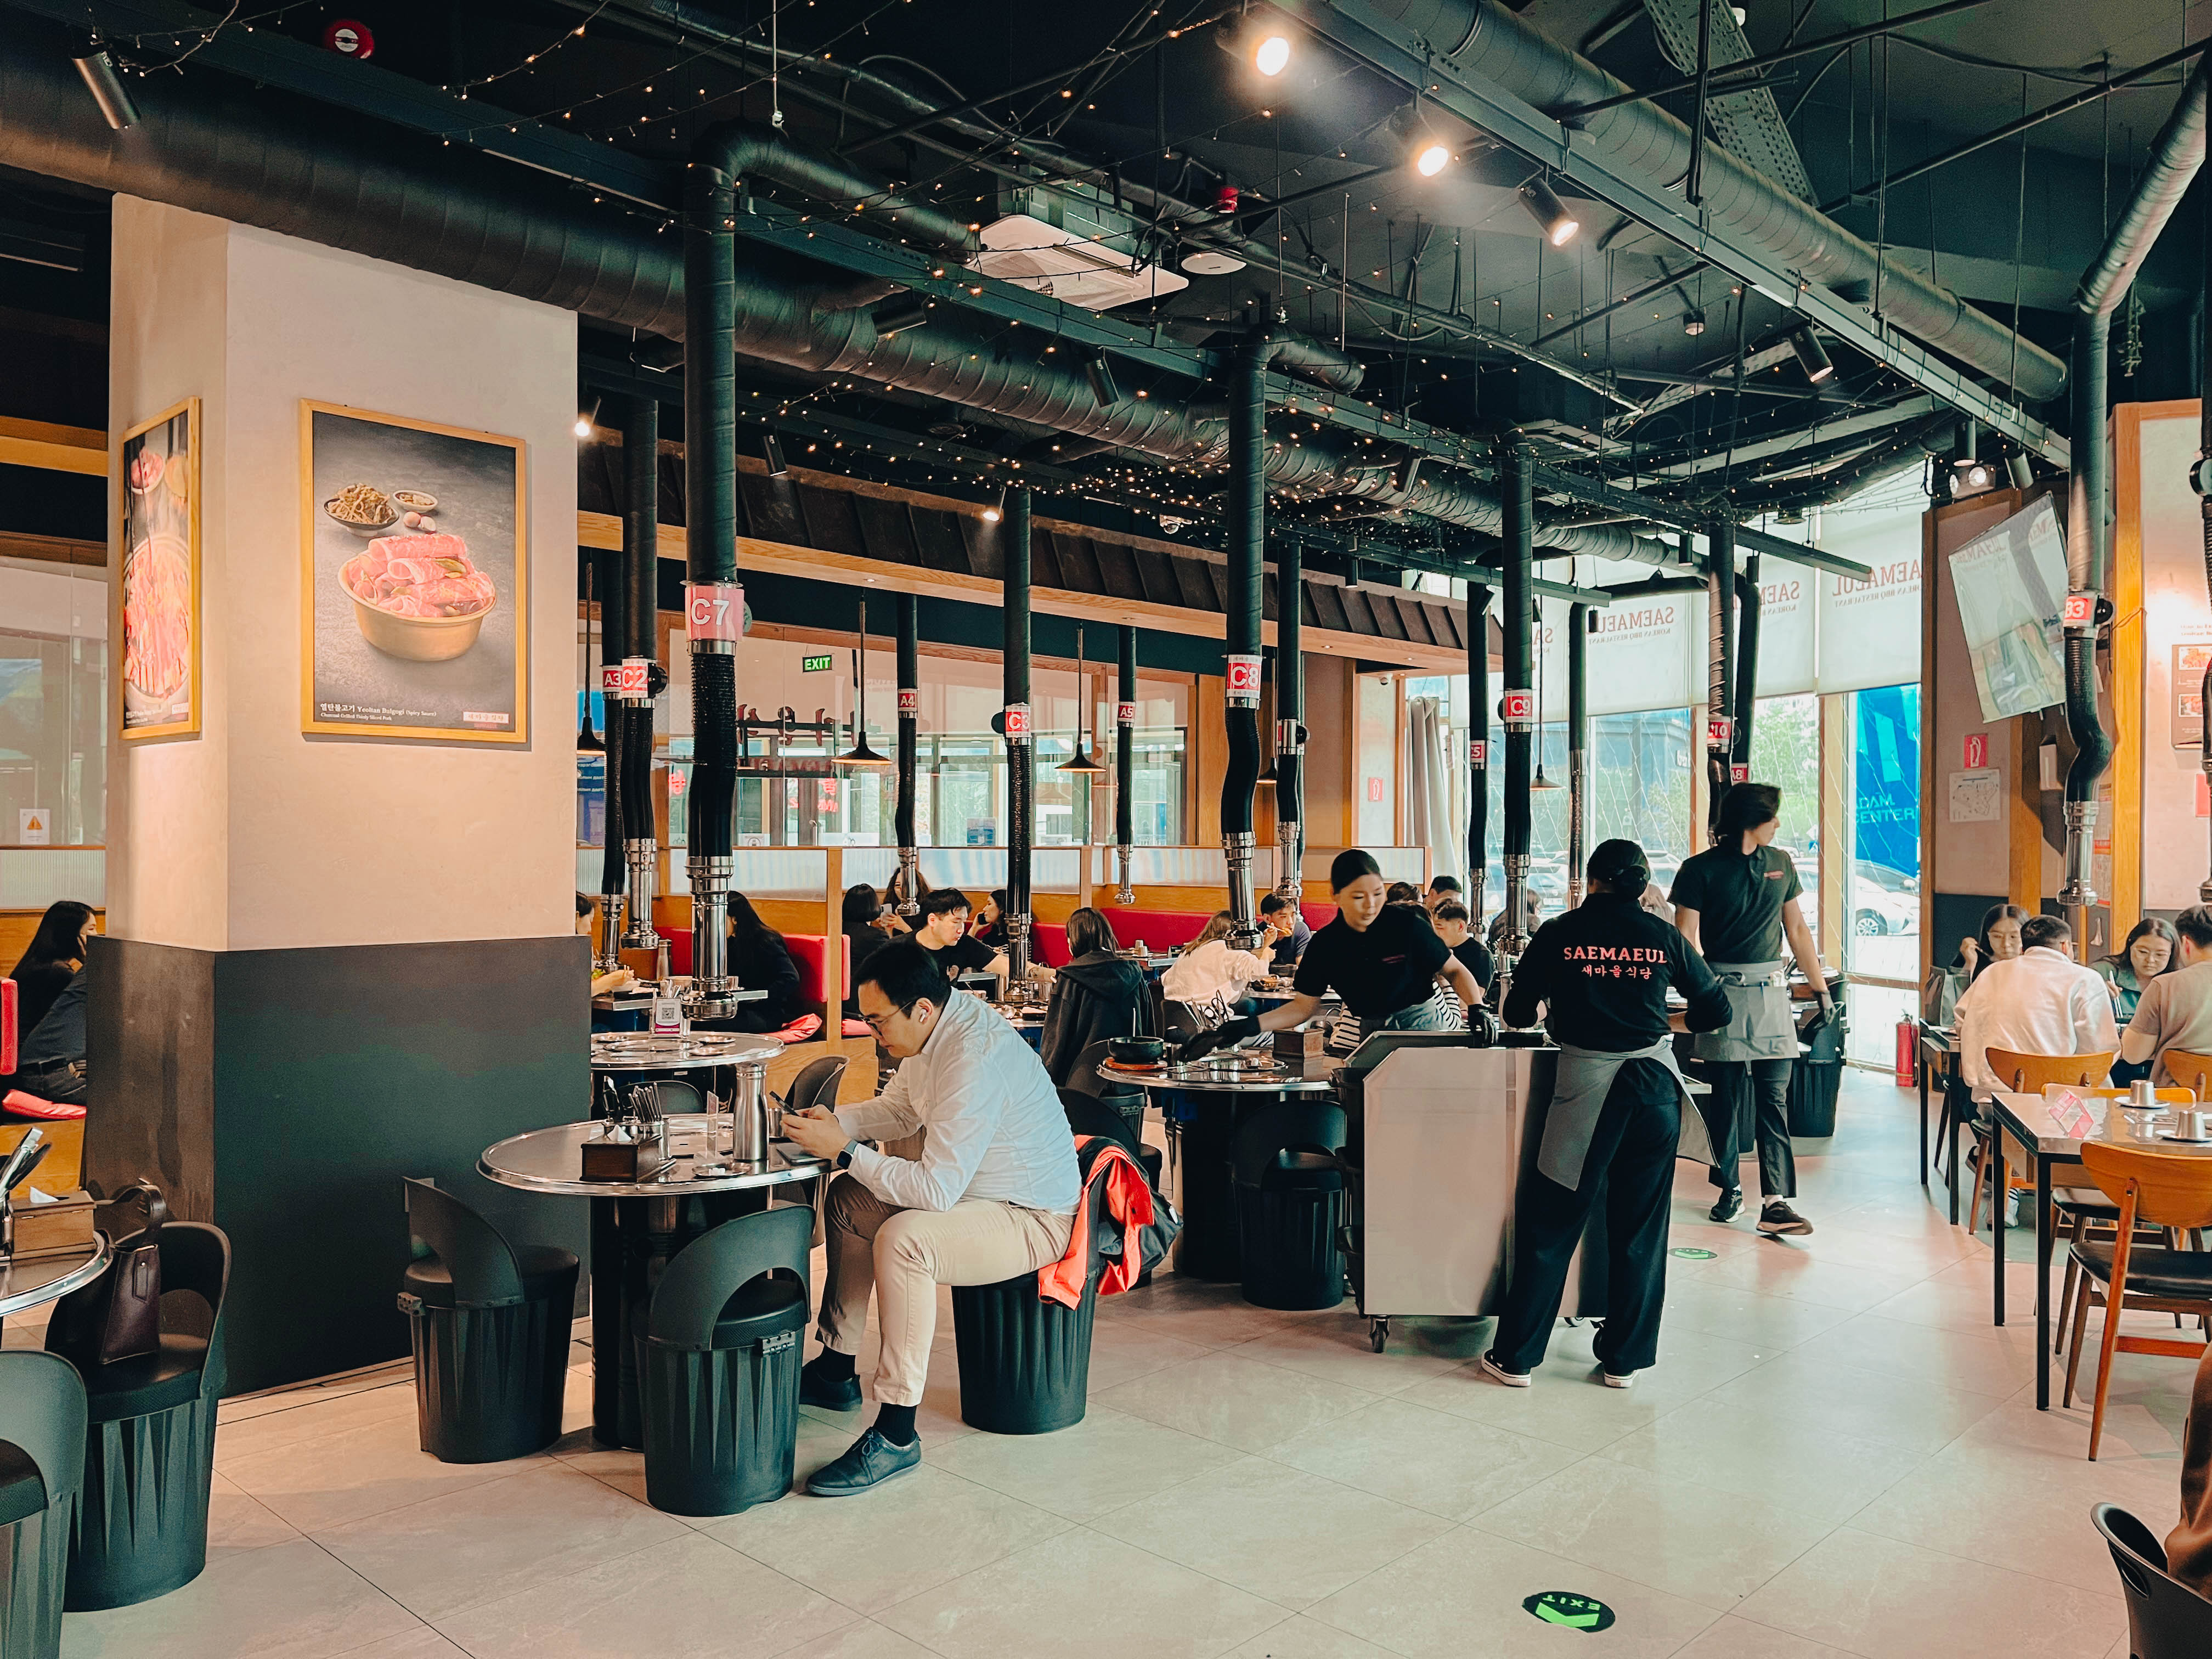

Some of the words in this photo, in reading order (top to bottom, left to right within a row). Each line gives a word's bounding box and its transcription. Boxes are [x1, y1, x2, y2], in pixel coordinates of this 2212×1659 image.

[691, 598, 730, 625] C7
[2065, 601, 2085, 618] B3
[804, 657, 831, 670] EXIT
[605, 673, 622, 686] A3
[623, 669, 647, 688] C2
[1232, 665, 1259, 687] C8
[900, 695, 915, 706] A4
[1511, 699, 1531, 715] C9
[382, 707, 404, 716] Bulgogi
[1120, 707, 1133, 718] A5
[1008, 714, 1030, 730] C3
[1709, 724, 1727, 736] 10
[1857, 793, 1895, 809] DAM
[1564, 946, 1667, 963] SAEMAEUL
[1581, 964, 1652, 980] 새마을식당
[1542, 1594, 1601, 1611] EXIT
